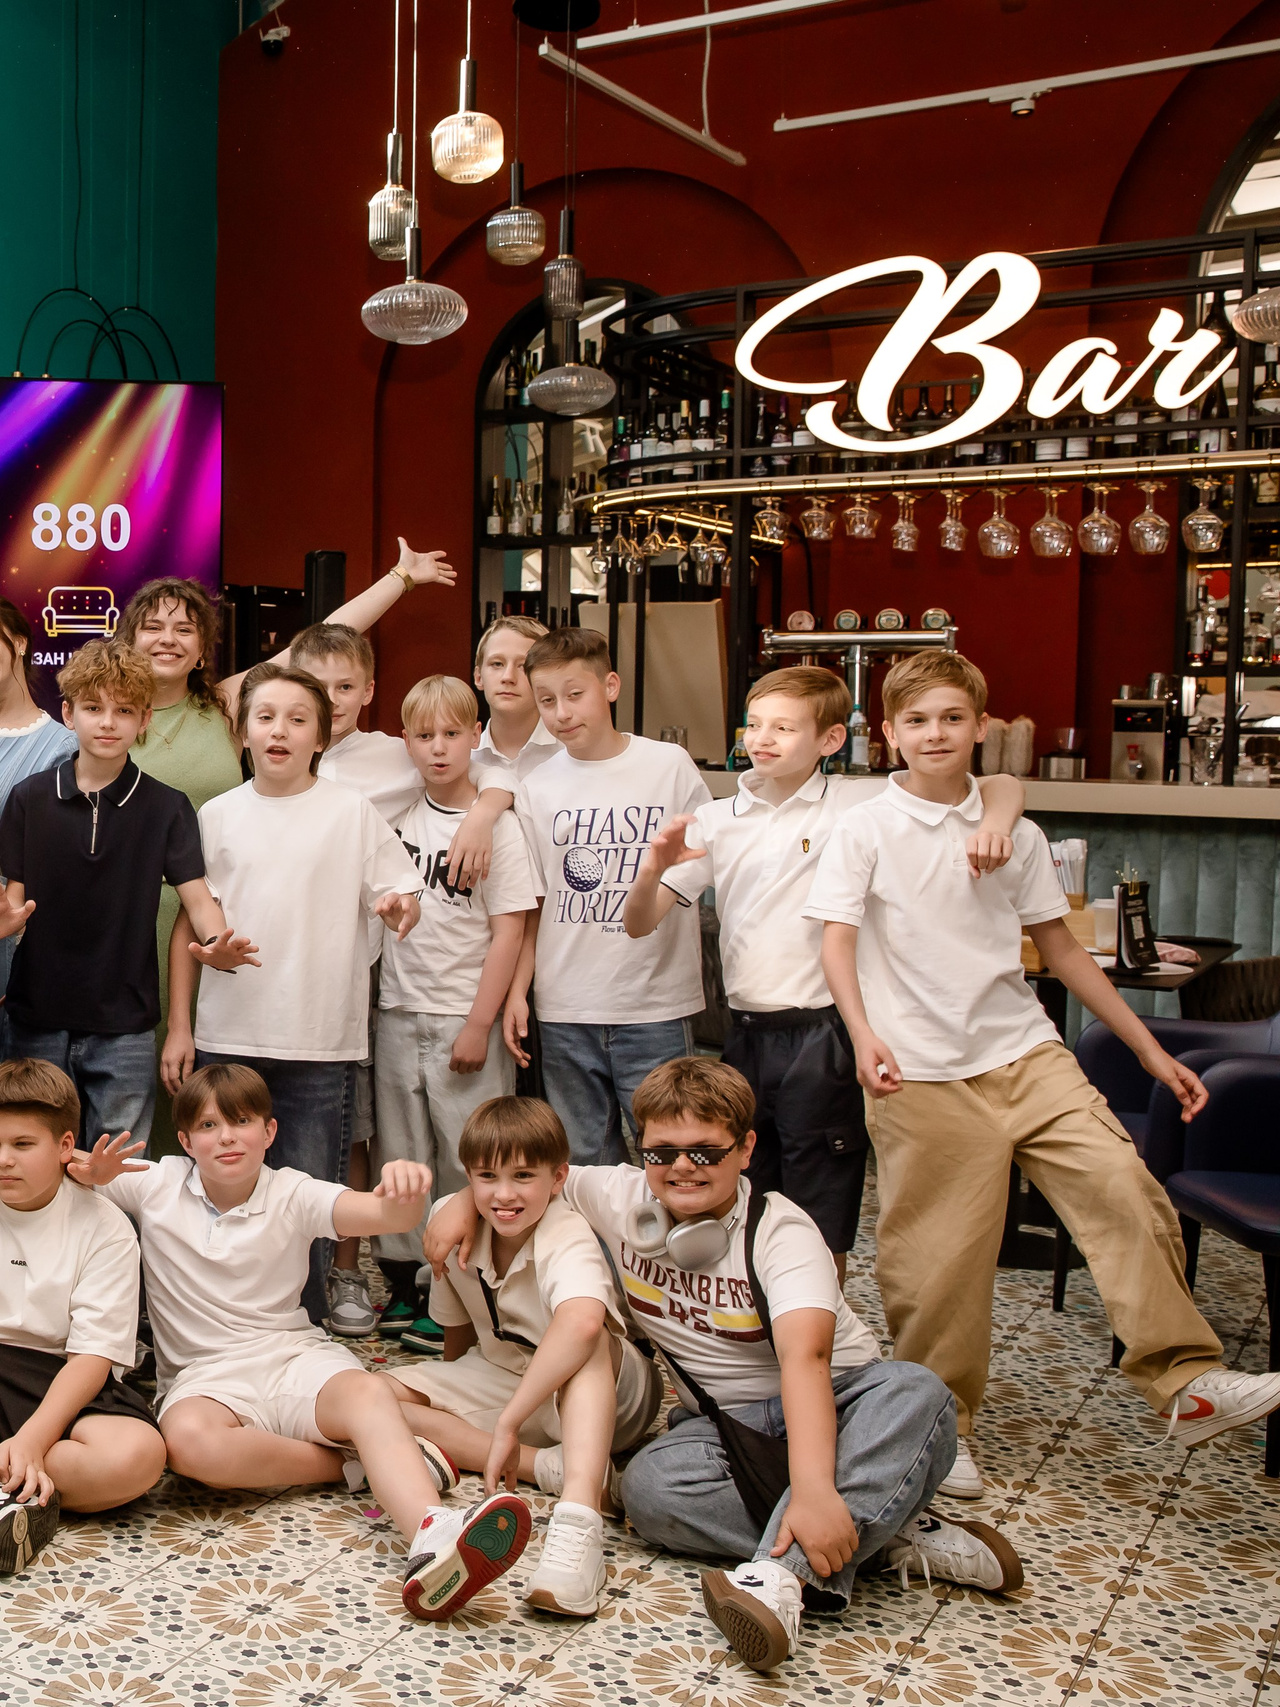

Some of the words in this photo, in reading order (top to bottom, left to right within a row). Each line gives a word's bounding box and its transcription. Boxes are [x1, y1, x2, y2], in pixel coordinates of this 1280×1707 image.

[734, 250, 1238, 453] Bar
[31, 502, 131, 551] 880
[31, 651, 65, 666] ЗАН
[552, 805, 665, 847] CHASE
[597, 847, 651, 885] TH
[553, 889, 628, 924] HORIZ
[621, 1241, 755, 1309] LINDENBERG
[669, 1297, 713, 1337] 45
[429, 1570, 460, 1605] JORDAN
